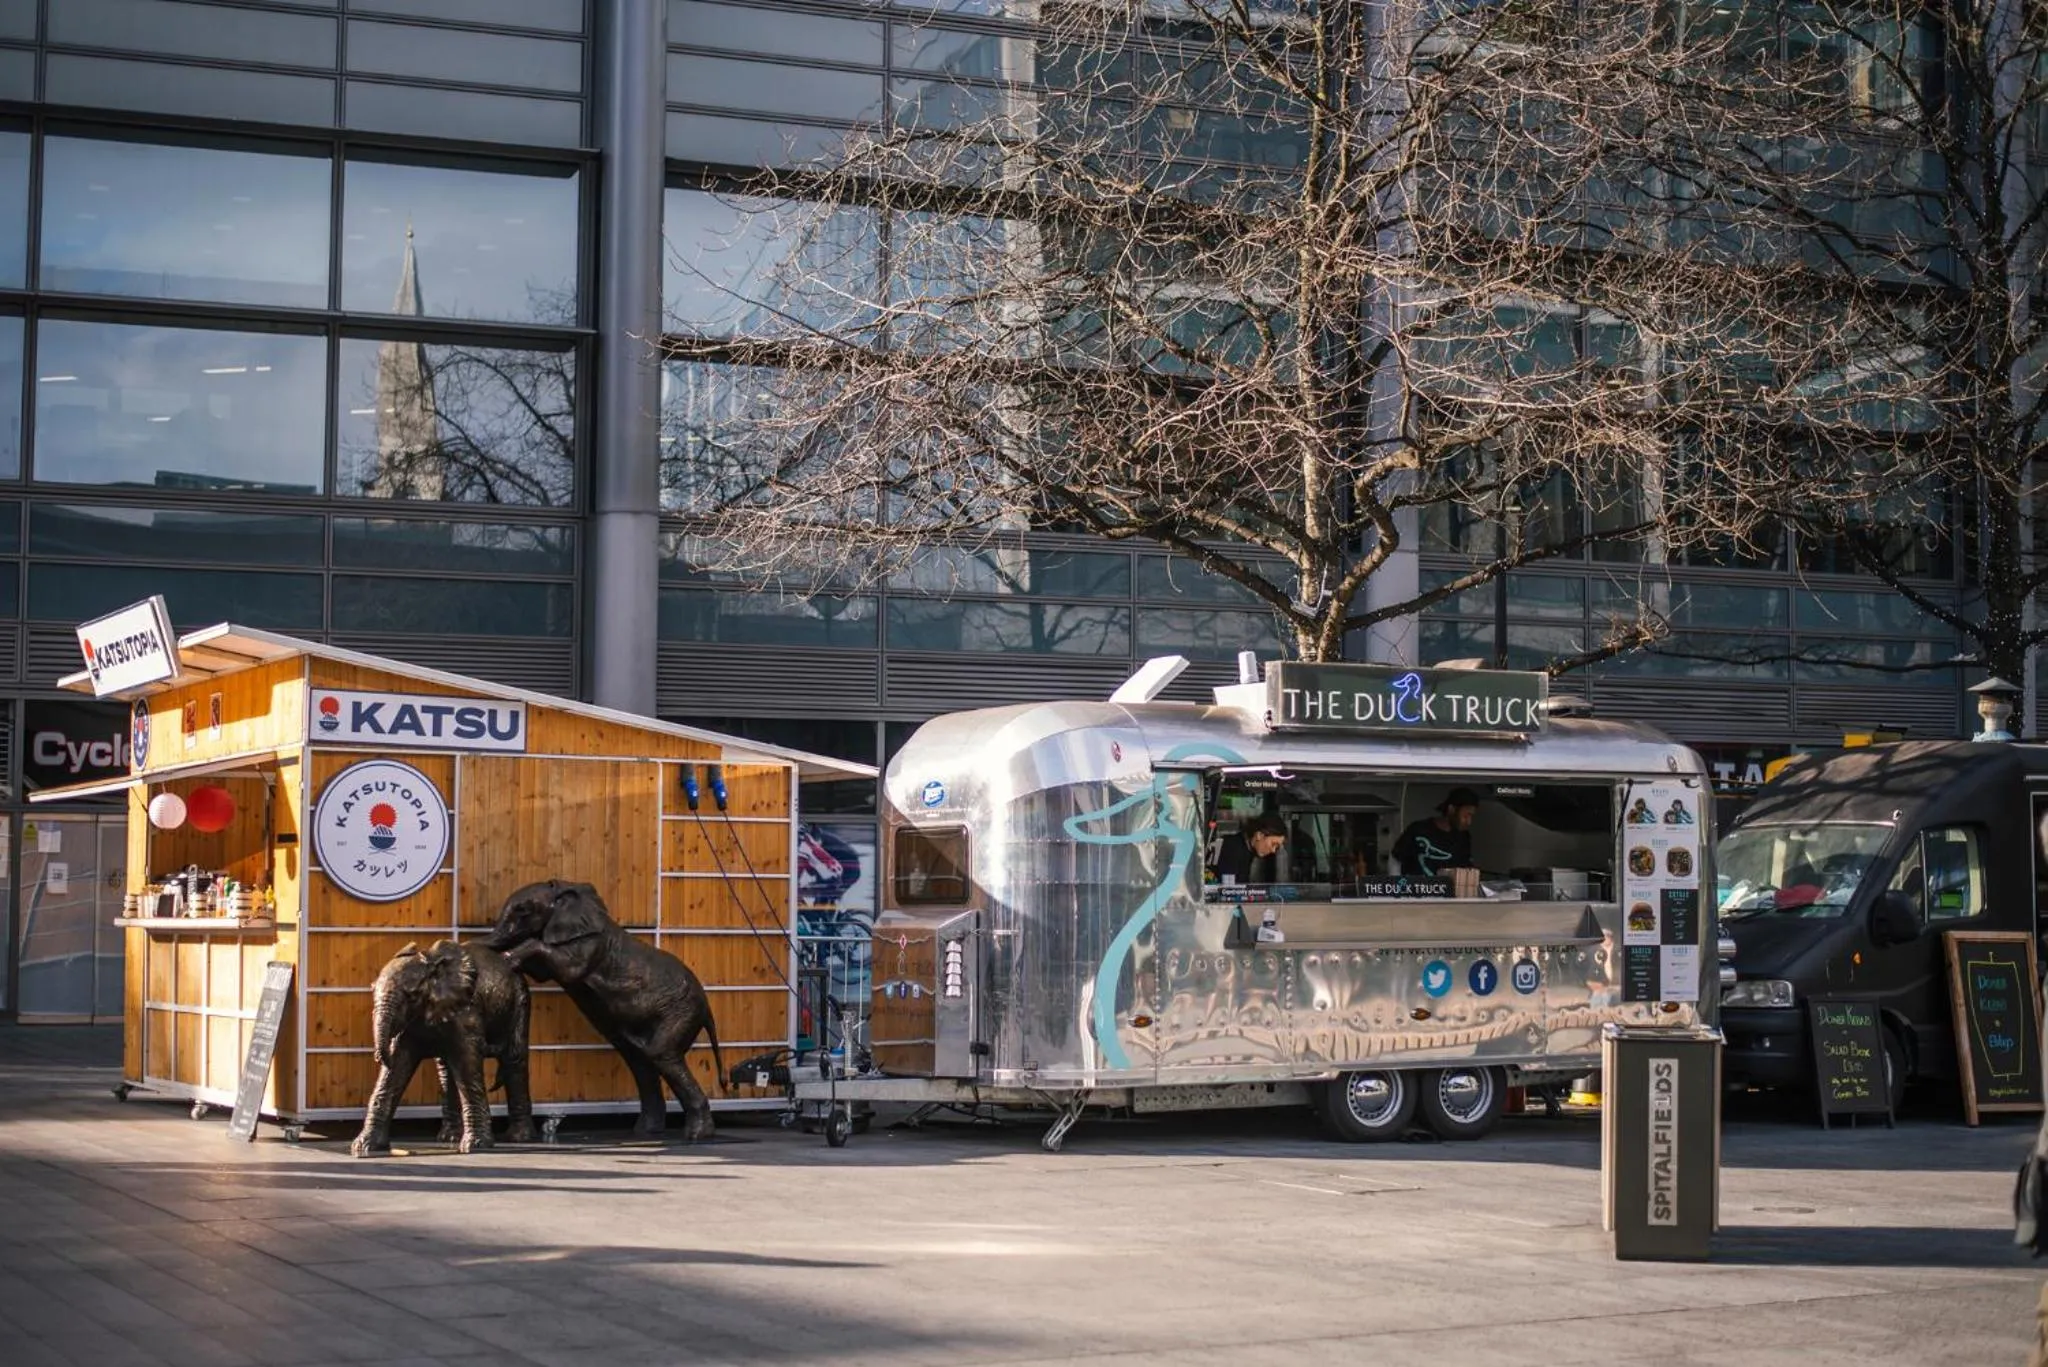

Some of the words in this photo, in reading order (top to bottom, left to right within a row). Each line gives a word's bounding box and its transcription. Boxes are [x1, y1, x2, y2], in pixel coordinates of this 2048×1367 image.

[96, 629, 160, 671] KATSUTOPIA
[351, 701, 520, 741] KATSU
[1284, 689, 1342, 719] THE
[1354, 679, 1436, 722] DUCK
[1444, 694, 1541, 726] TRUCK
[335, 781, 430, 832] KATSUTOPIA
[353, 859, 408, 878] カツレツ
[1365, 884, 1382, 893] THE
[1415, 884, 1445, 894] TRUCK
[1654, 1063, 1672, 1220] SPITALFIELDS
